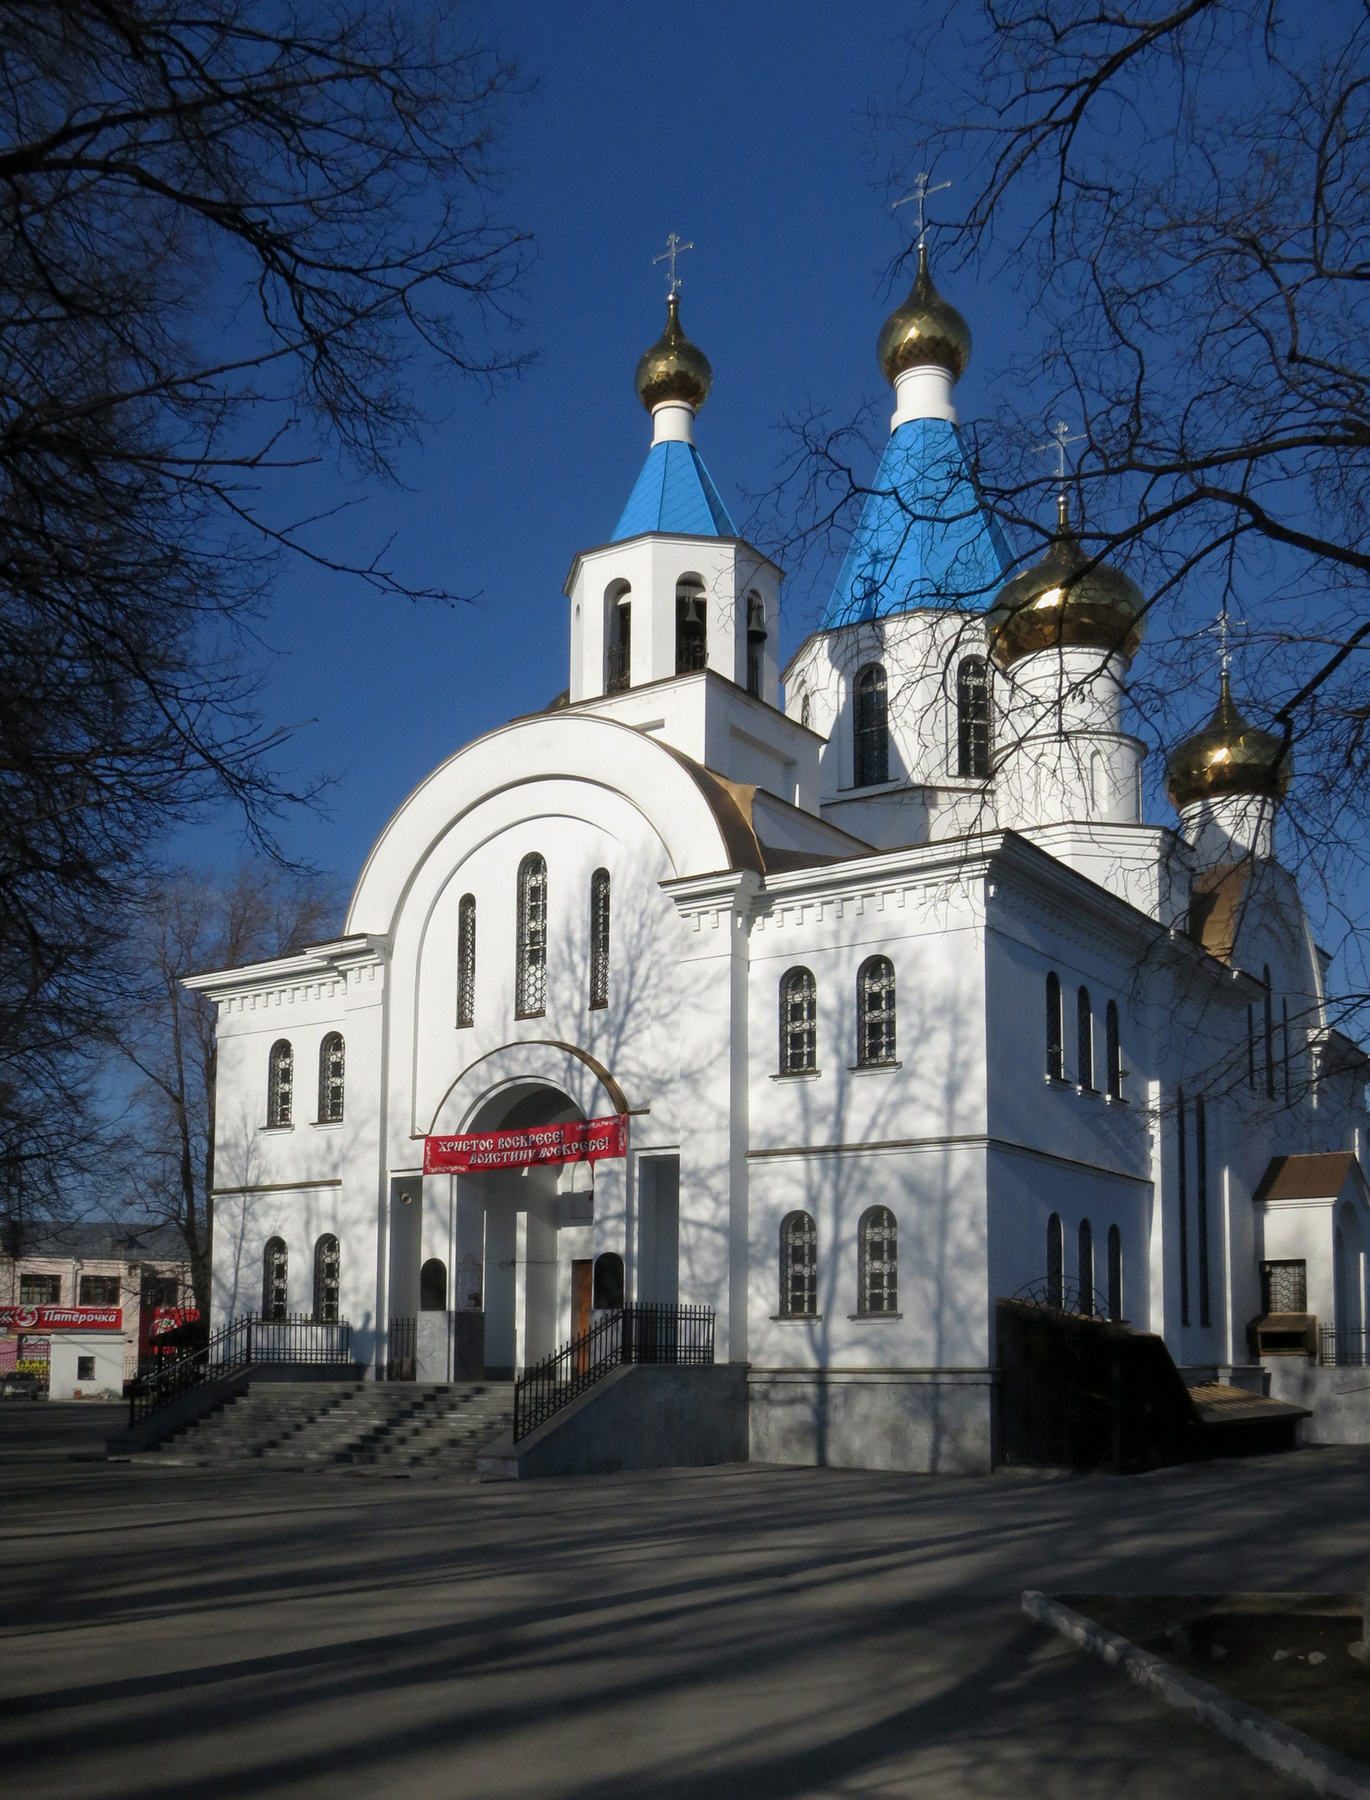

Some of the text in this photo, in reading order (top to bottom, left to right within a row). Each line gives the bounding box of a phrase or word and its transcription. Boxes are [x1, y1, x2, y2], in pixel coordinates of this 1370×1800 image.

[438, 1129, 565, 1153] ХРИСТОС ВОСКРЕСЕ!
[468, 1136, 610, 1164] ВОИСТИНУ ВОСКРЕСЕ!
